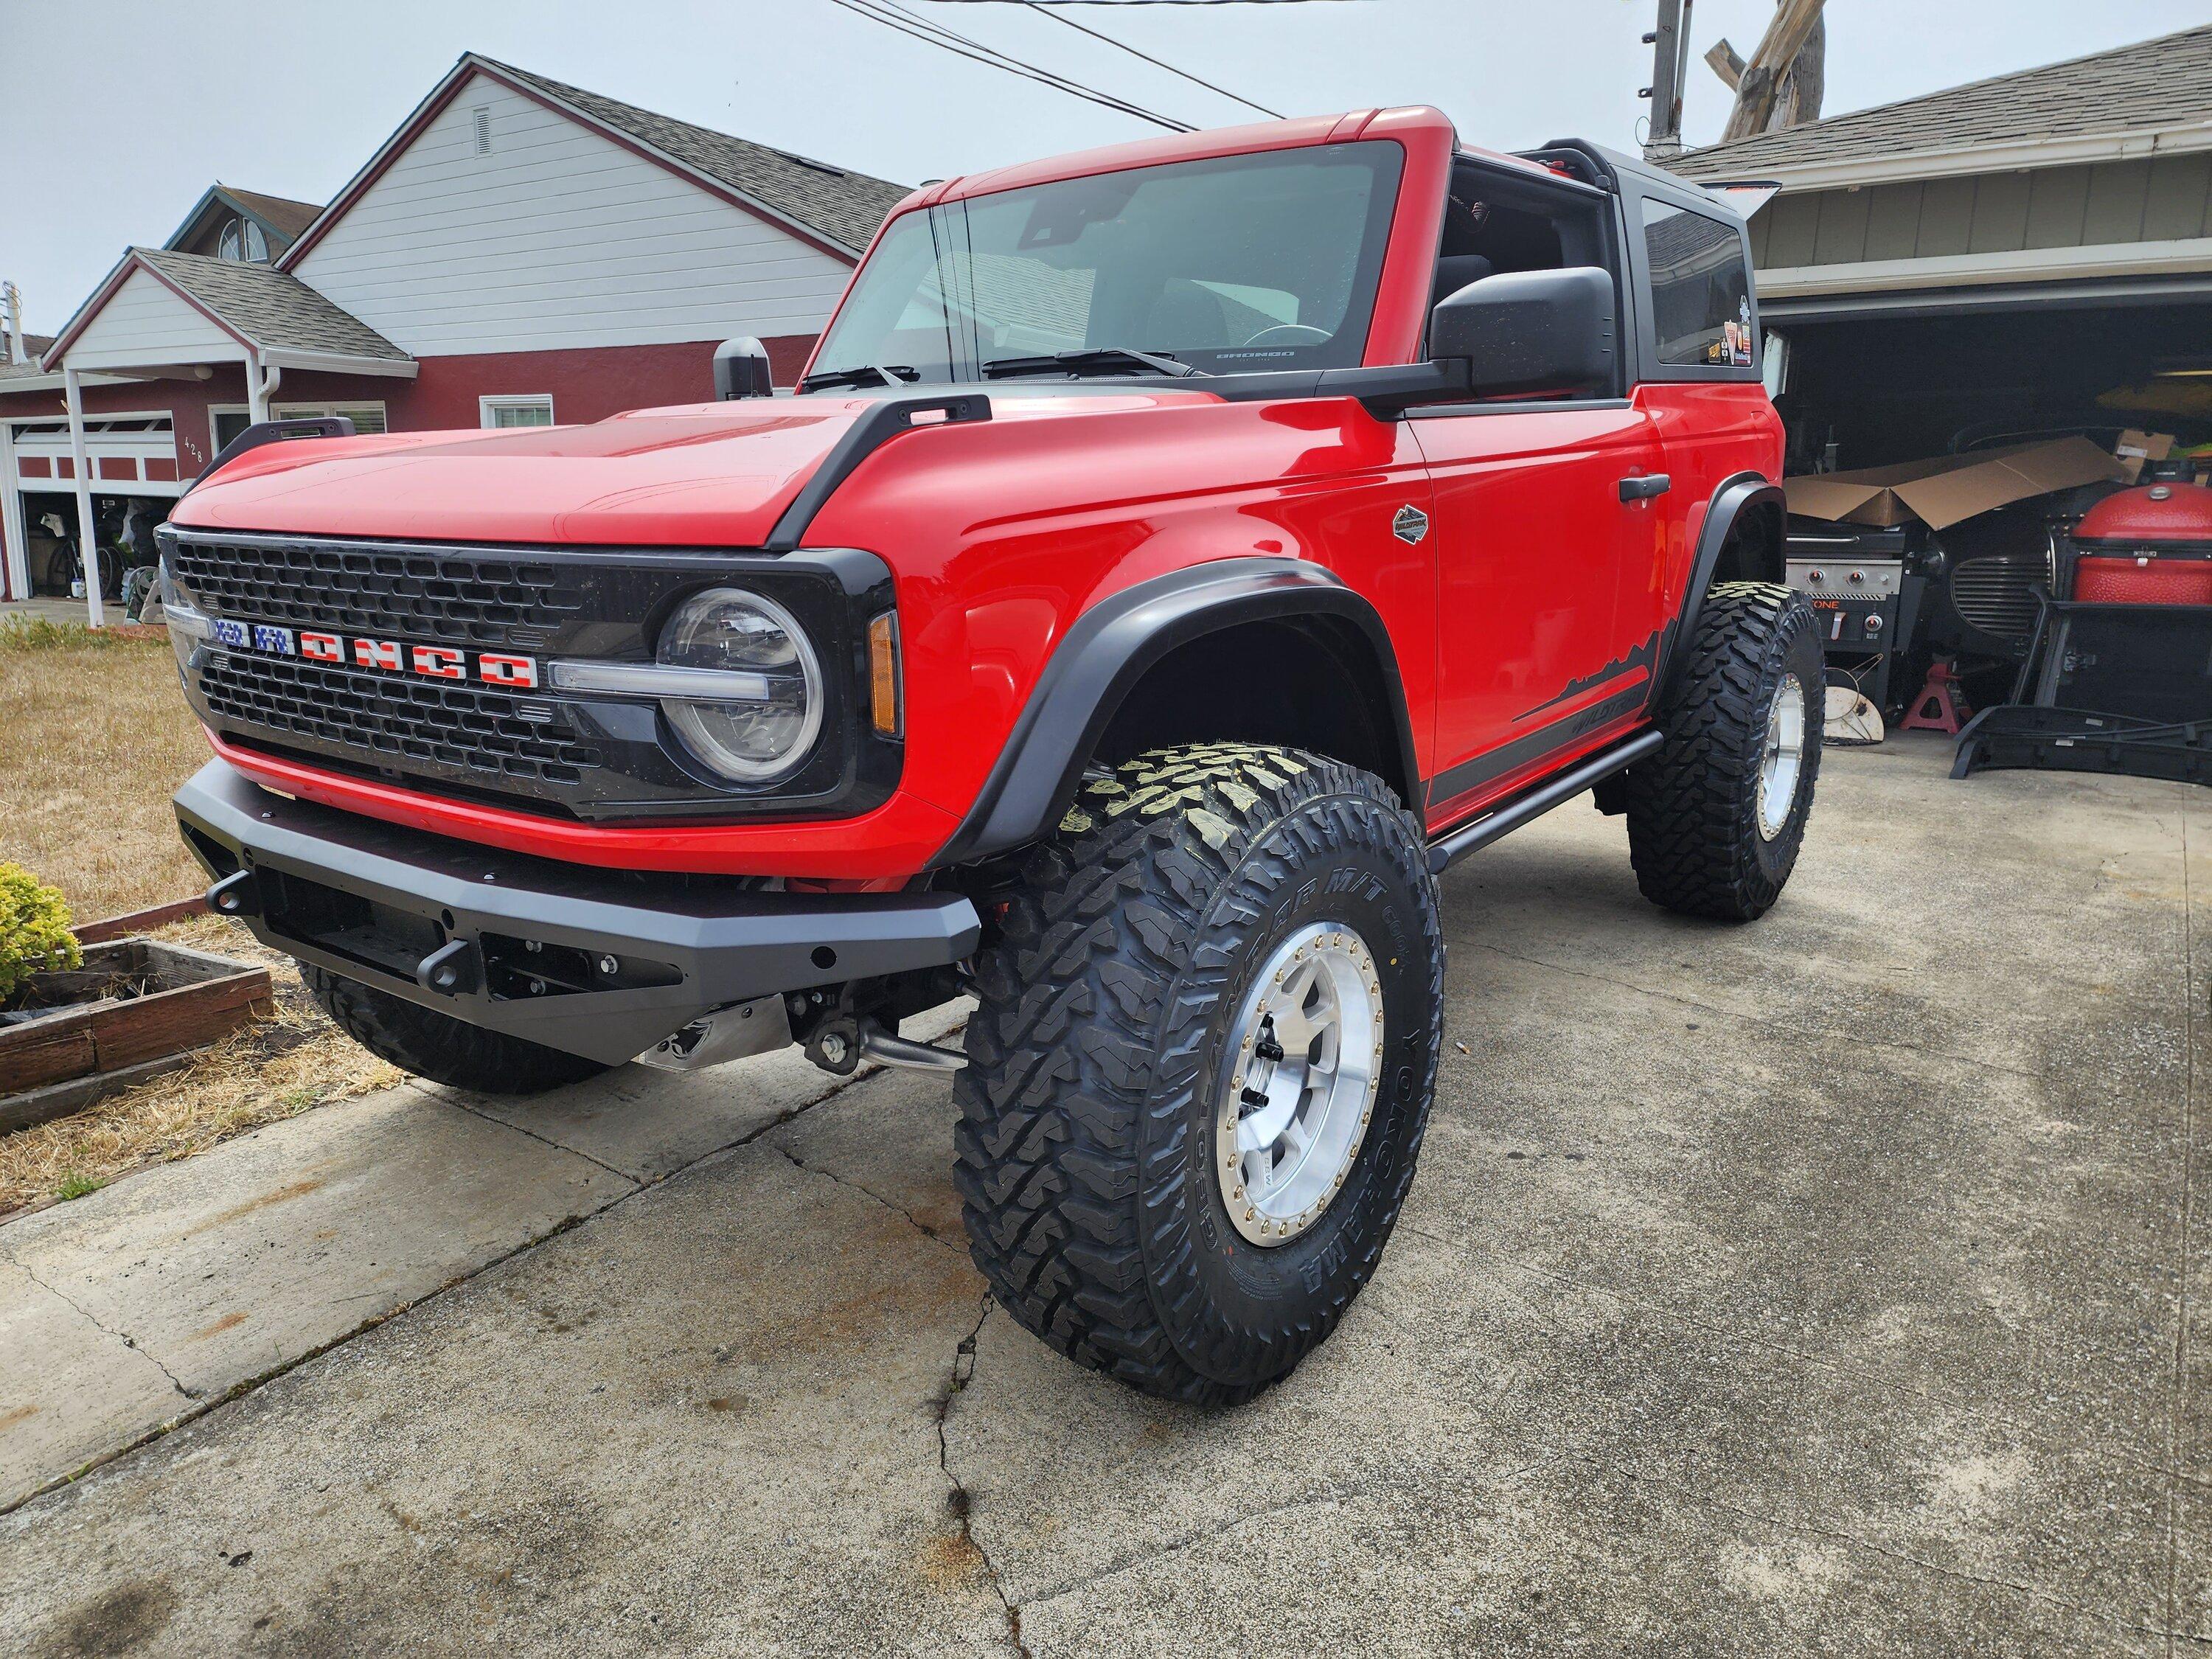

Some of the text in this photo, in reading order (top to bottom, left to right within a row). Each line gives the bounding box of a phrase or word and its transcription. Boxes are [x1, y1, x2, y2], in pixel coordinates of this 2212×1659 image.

[1216, 351, 1295, 359] BRONCO
[184, 436, 203, 463] 428
[1812, 600, 1840, 609] ONE
[215, 618, 538, 689] BRONCO
[1298, 1027, 1421, 1295] YOKOHAMA
